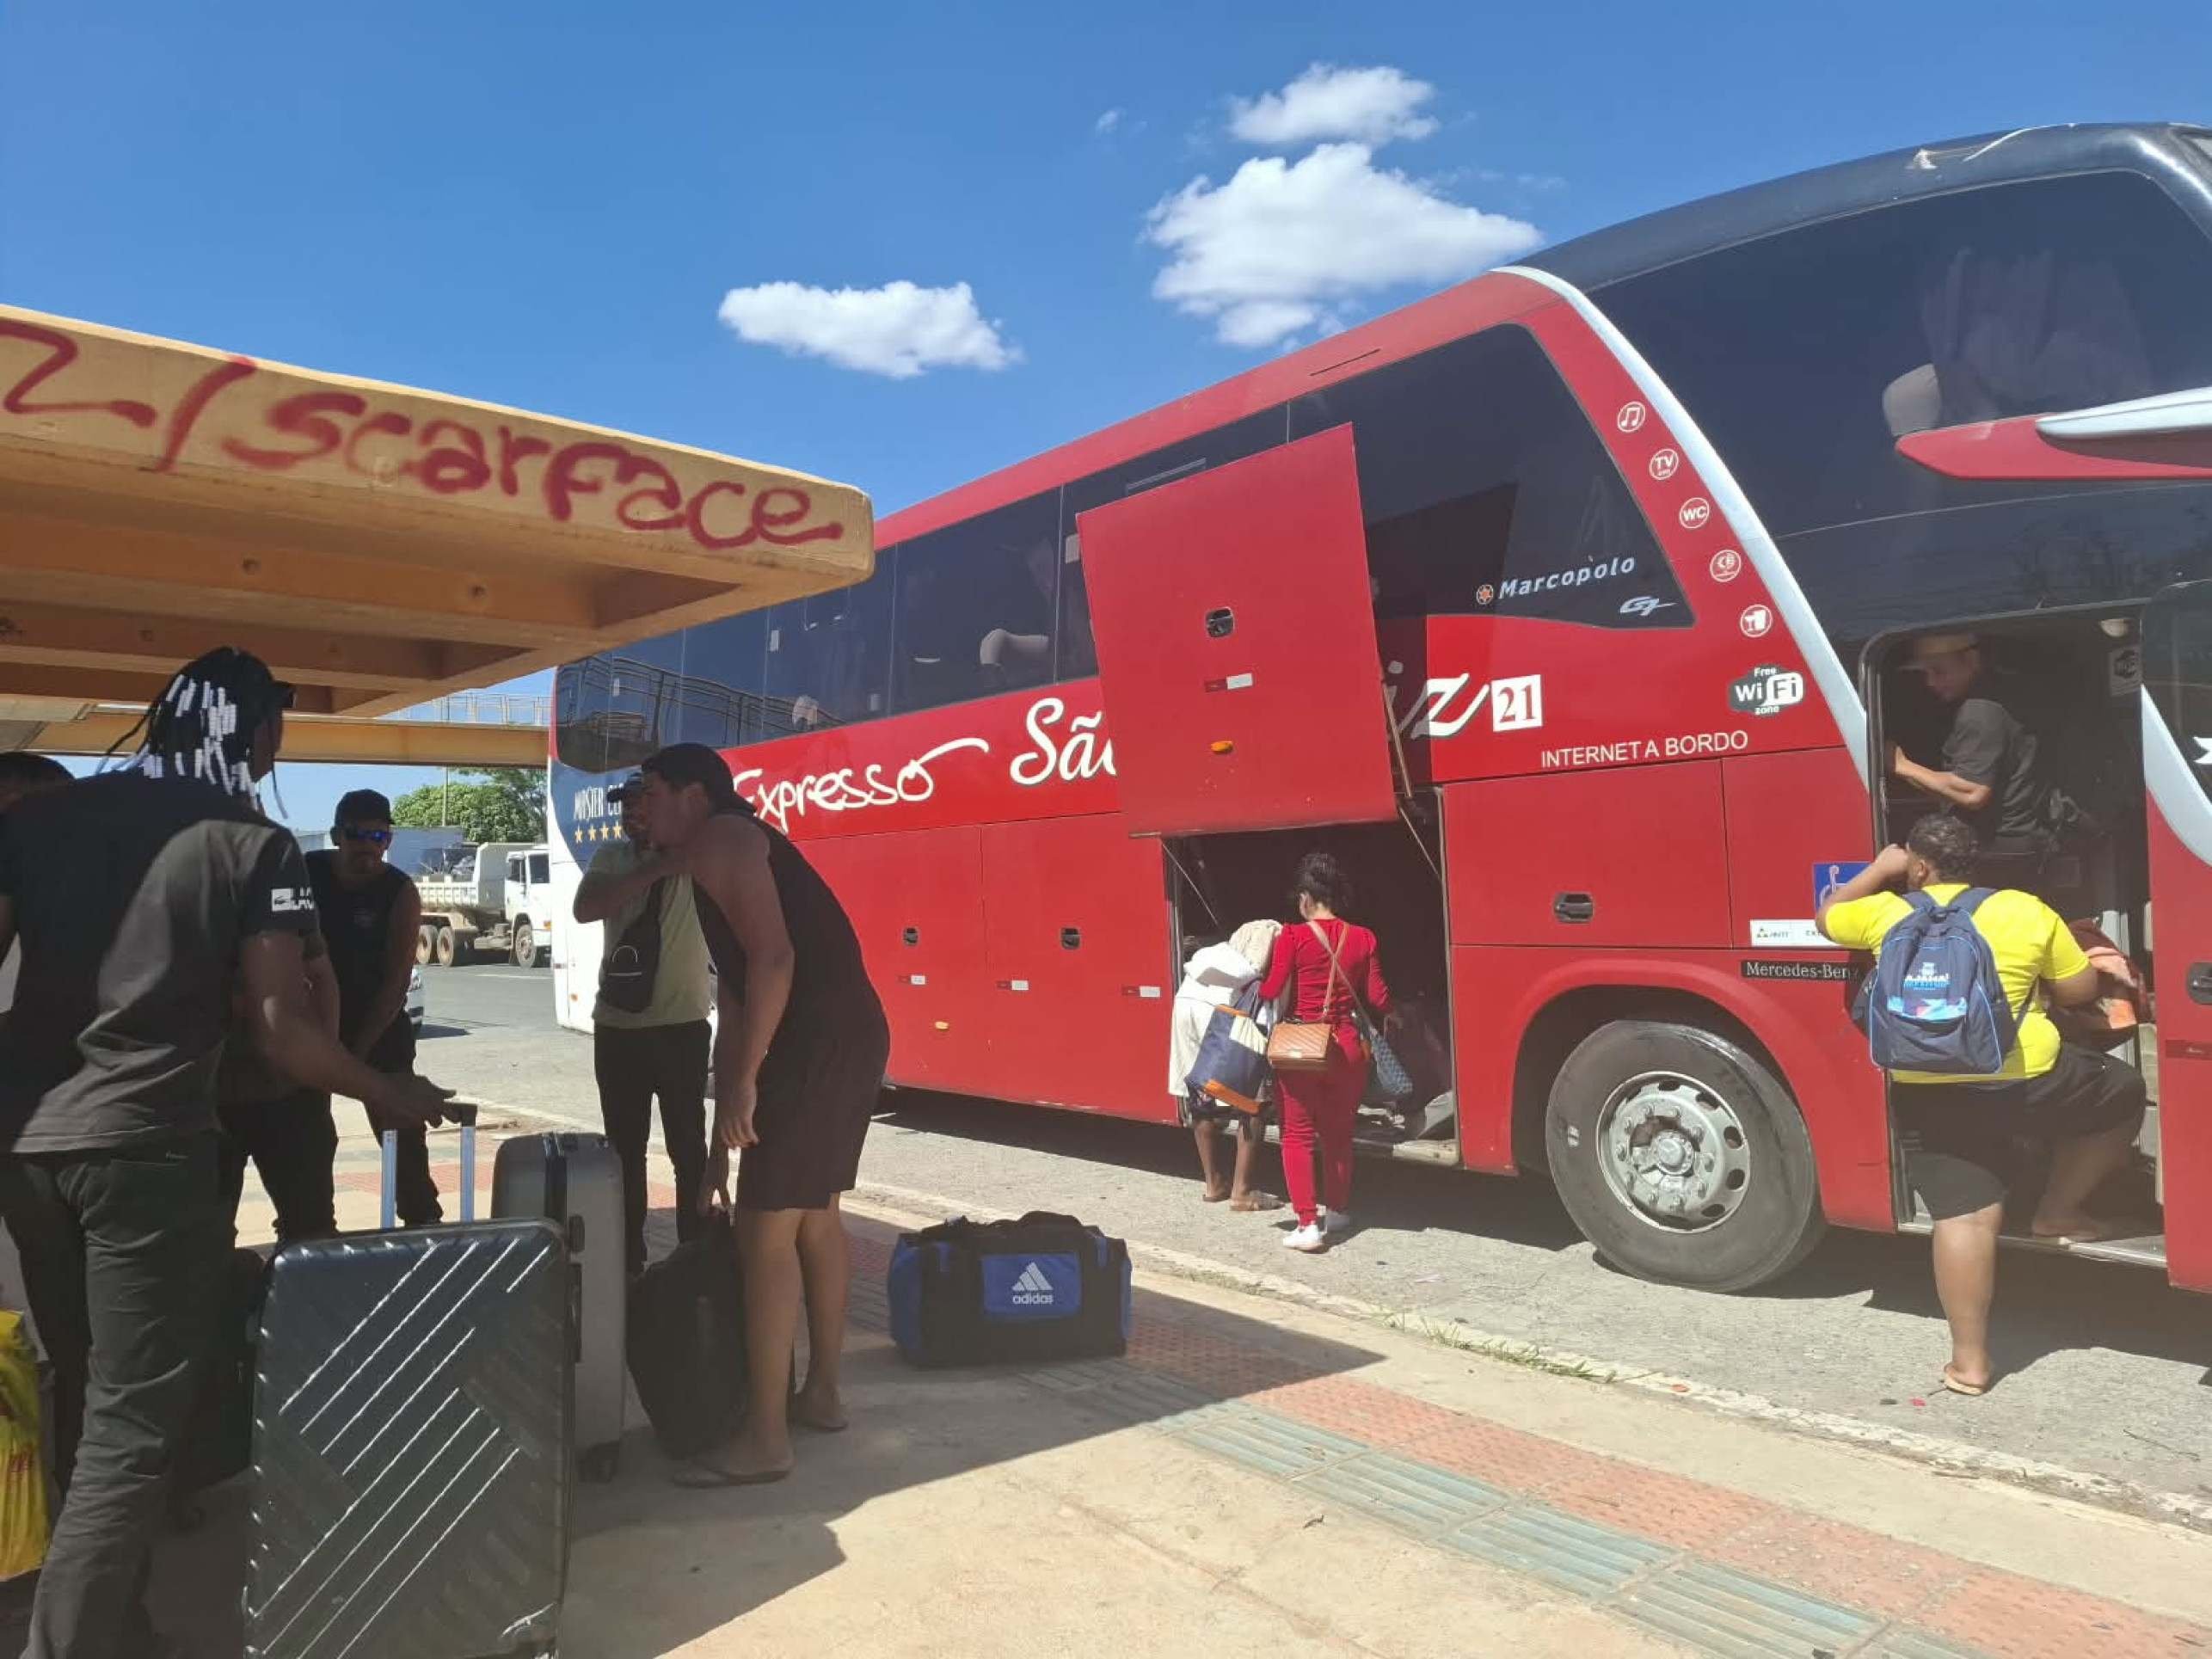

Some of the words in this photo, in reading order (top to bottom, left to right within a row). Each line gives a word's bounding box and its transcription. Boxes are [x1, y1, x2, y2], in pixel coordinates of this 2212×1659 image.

[1655, 455, 1674, 470] TV
[1683, 505, 1707, 522] WC
[1498, 556, 1635, 599] Marcopolo
[1754, 667, 1777, 677] Free
[1497, 683, 1537, 724] 21
[1541, 740, 1642, 768] INTERNET
[1644, 739, 1660, 759] A
[1665, 729, 1749, 756] BORDO
[1012, 1293, 1054, 1305] adidas
